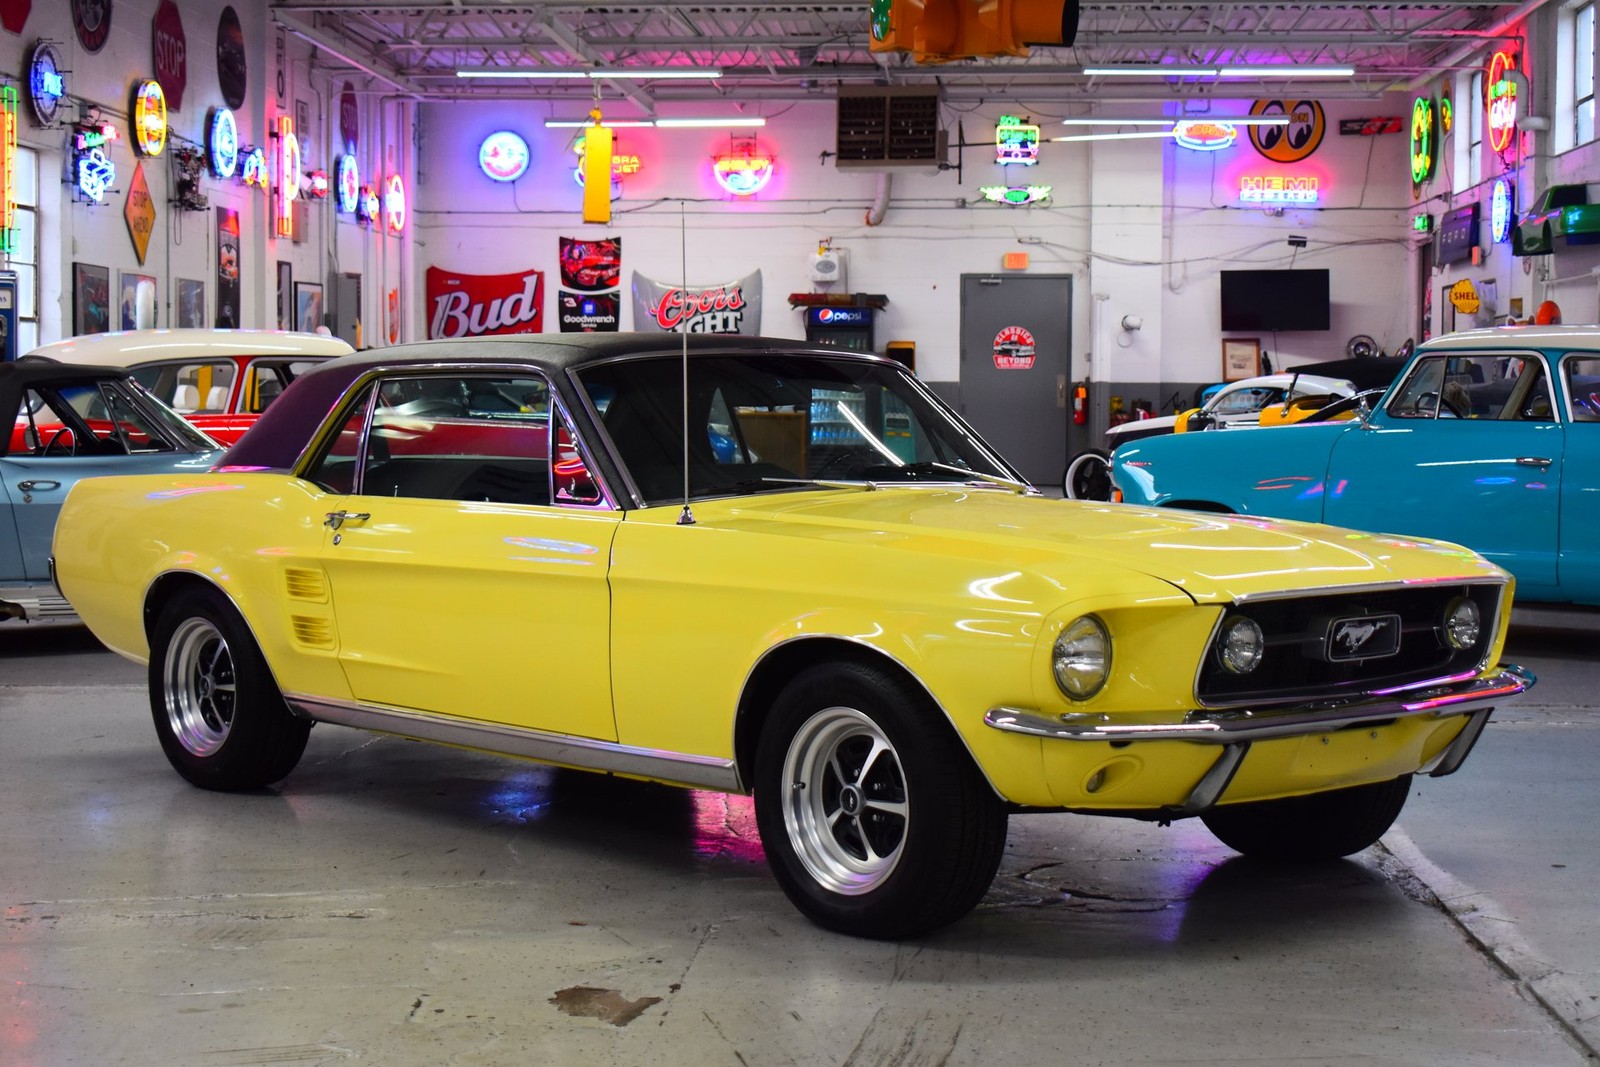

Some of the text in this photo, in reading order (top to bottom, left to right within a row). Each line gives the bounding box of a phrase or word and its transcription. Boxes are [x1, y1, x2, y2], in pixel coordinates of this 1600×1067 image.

[156, 30, 185, 78] STOP
[613, 164, 640, 173] JET
[1241, 177, 1318, 191] HEMI
[133, 191, 148, 207] STOP
[133, 216, 149, 233] AHEAD
[1442, 228, 1466, 244] FORD
[430, 274, 539, 338] Bud
[563, 297, 577, 307] 3
[650, 286, 747, 329] Coors
[563, 315, 615, 323] Goodwrench
[669, 311, 742, 334] GHT
[834, 311, 862, 322] pepsi
[995, 327, 1034, 344] CLASSICS
[997, 356, 1032, 364] BEYOND
